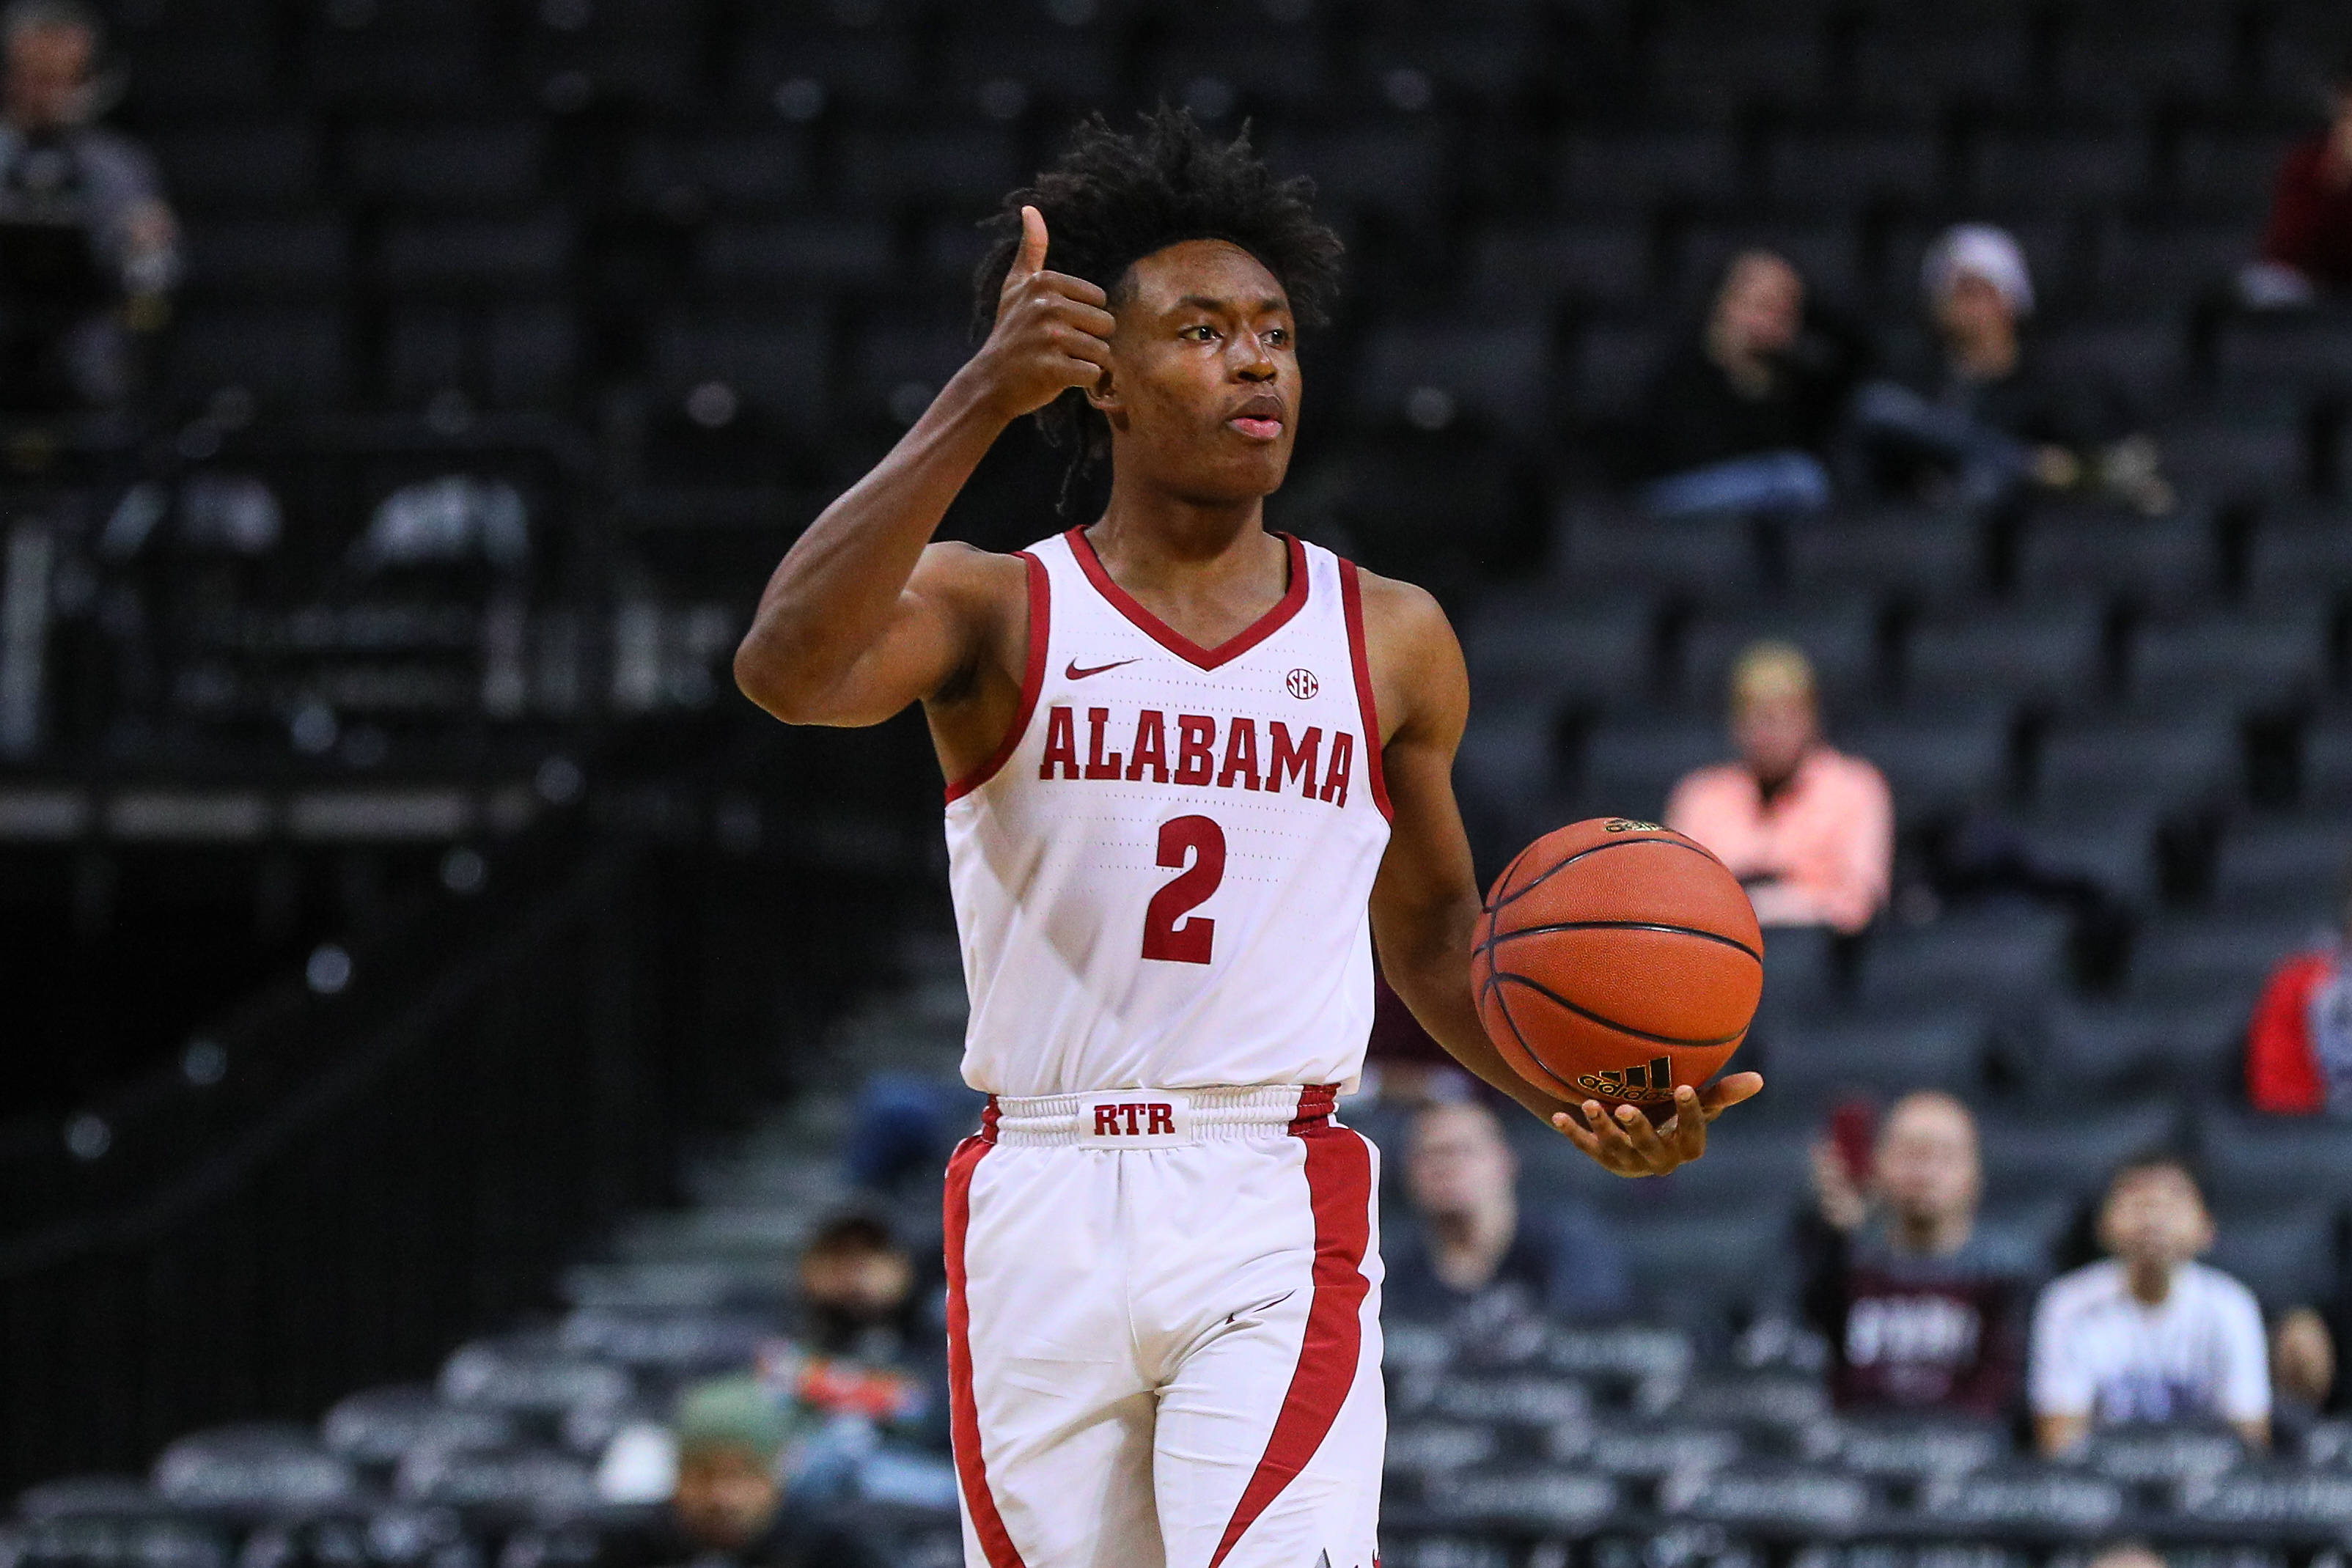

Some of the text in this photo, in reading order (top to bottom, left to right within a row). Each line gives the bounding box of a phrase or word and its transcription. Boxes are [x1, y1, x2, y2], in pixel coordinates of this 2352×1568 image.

[1286, 668, 1319, 699] SEC
[1039, 706, 1354, 808] ALABAMA
[1142, 814, 1227, 965] 2
[1094, 1103, 1176, 1135] RTR
